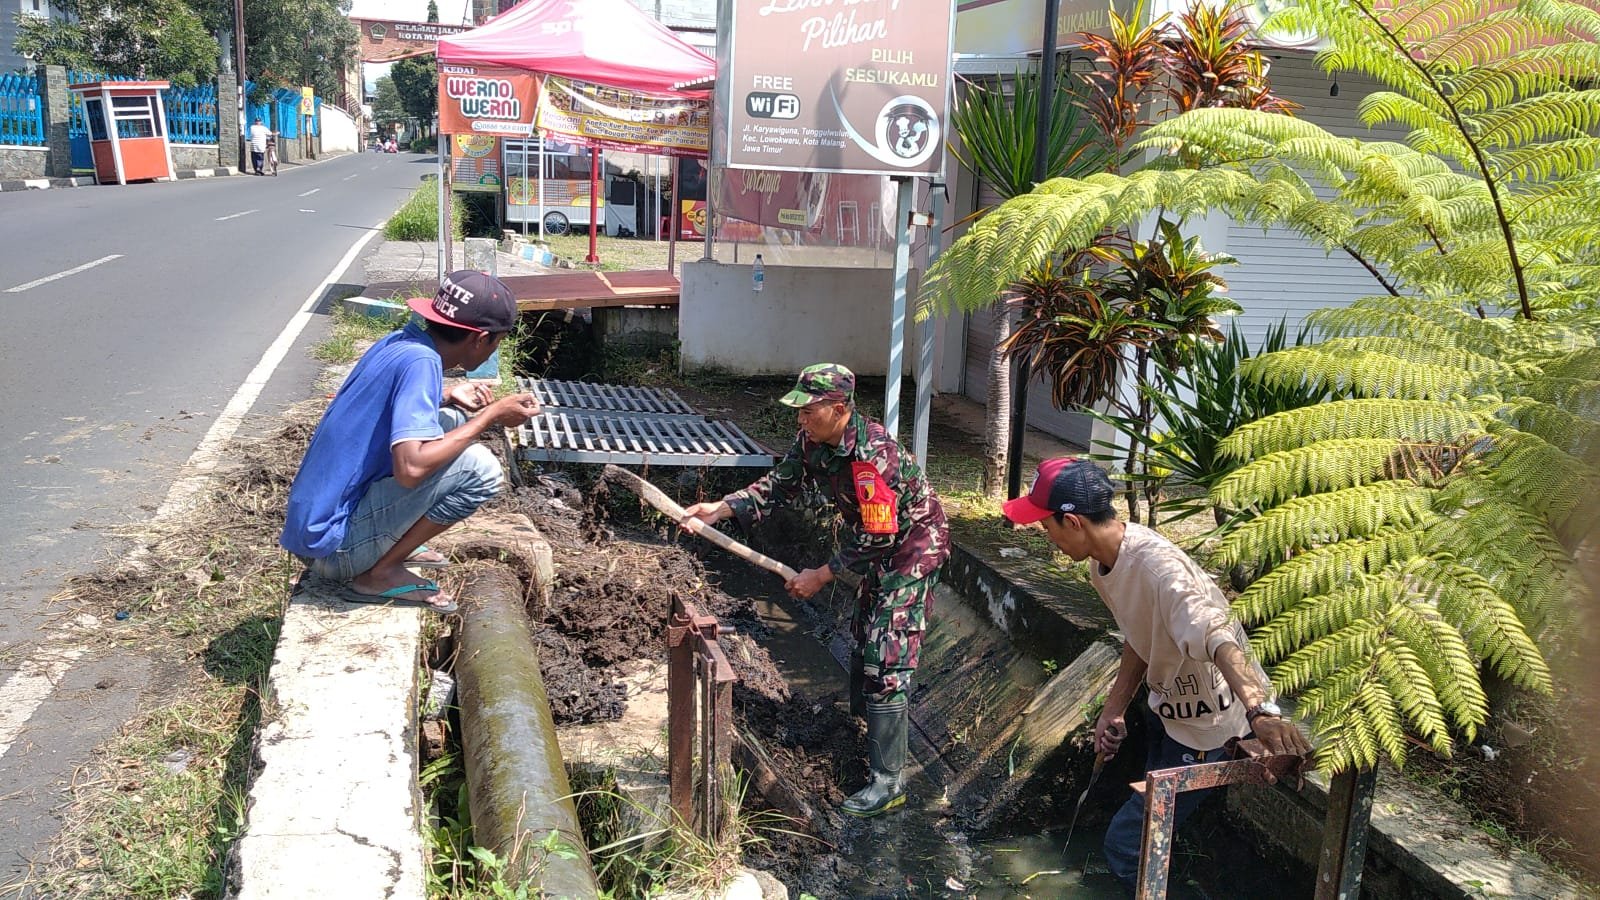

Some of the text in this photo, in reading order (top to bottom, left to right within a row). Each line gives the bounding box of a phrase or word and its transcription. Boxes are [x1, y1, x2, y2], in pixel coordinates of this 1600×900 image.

[394, 23, 437, 34] SELAMAT
[1057, 8, 1104, 34] SUKAMU
[802, 11, 888, 51] Pilihan
[871, 48, 914, 64] PILIH
[443, 66, 474, 75] KEDAI
[845, 68, 938, 87] SESUKAMU
[448, 78, 511, 98] WERNO
[753, 75, 793, 90] FREE
[462, 98, 518, 117] WERNI
[742, 144, 783, 154] Jawa Timur
[803, 138, 819, 146] Kota
